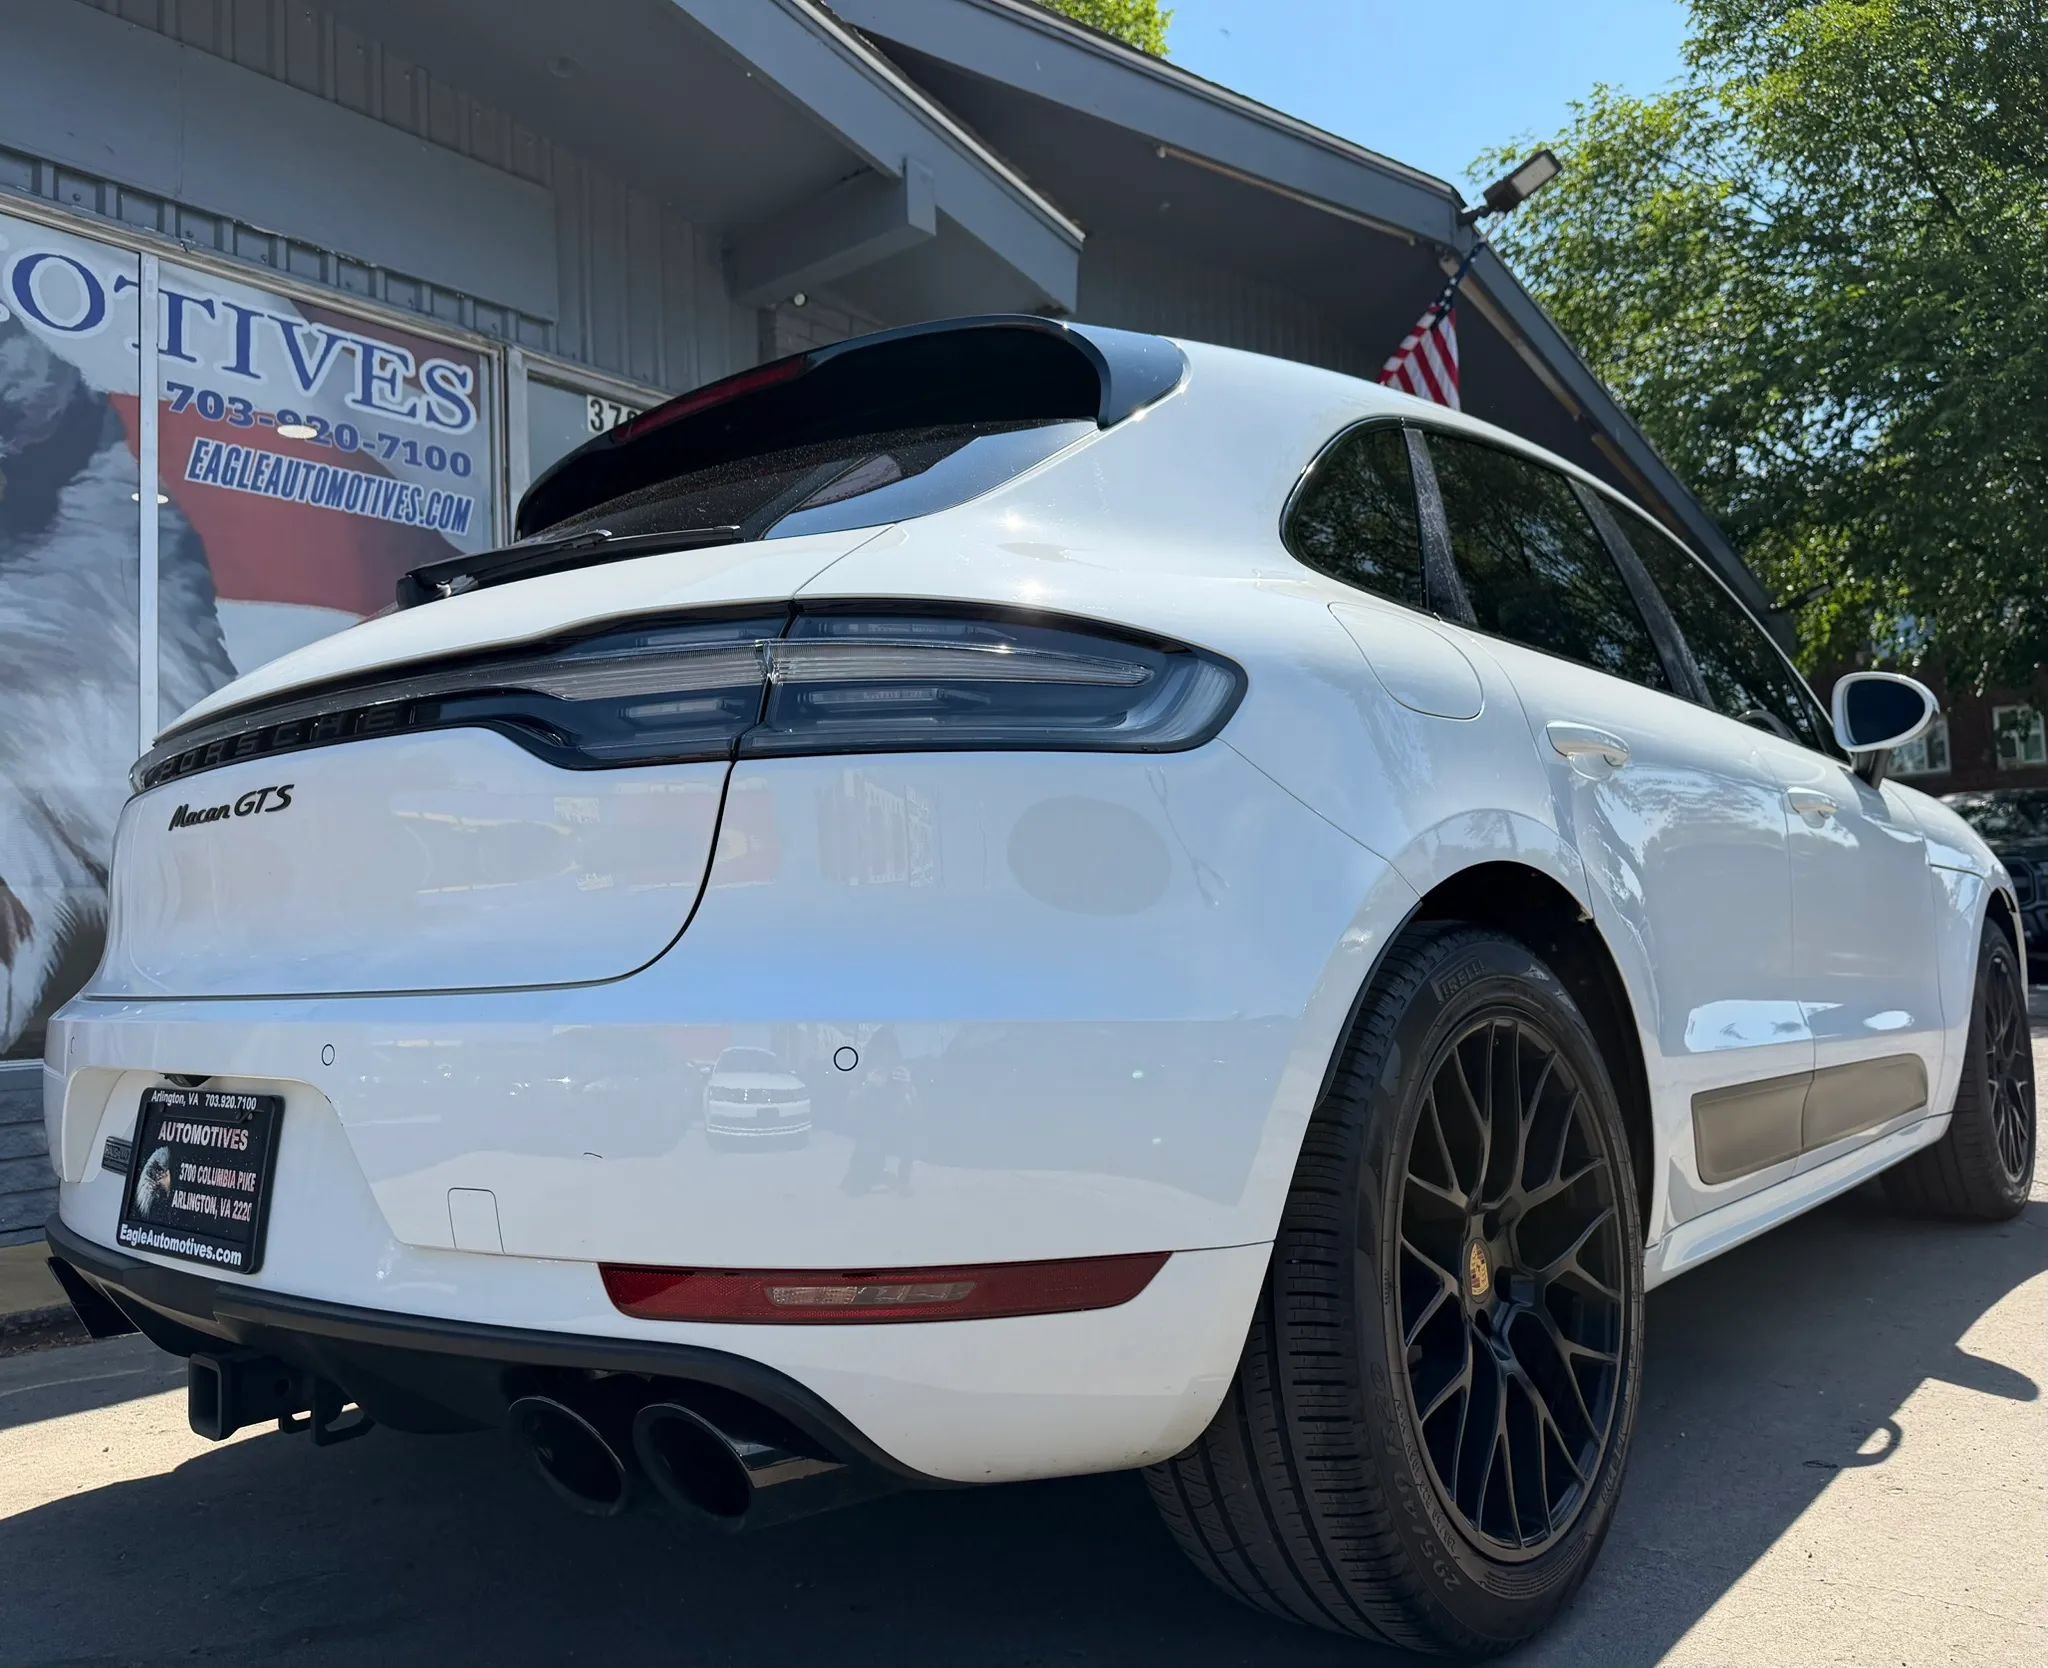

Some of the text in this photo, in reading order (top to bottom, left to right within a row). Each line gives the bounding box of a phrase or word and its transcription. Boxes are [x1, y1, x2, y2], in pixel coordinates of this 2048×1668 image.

[166, 381, 472, 478] 703-920-7100
[187, 440, 474, 534] EAGLEAUTOMOTIVES.COM
[168, 784, 295, 831] Macan GTS
[151, 1090, 257, 1110] Arlington, VA 703.920.7100
[158, 1120, 249, 1151] AUTOMOTIVES
[179, 1163, 257, 1192] 3700 COLUMBIA PIKE
[171, 1190, 218, 1220] ARLINGTON,
[219, 1198, 232, 1219] VA
[119, 1223, 242, 1266] EagleAutomotives.com
